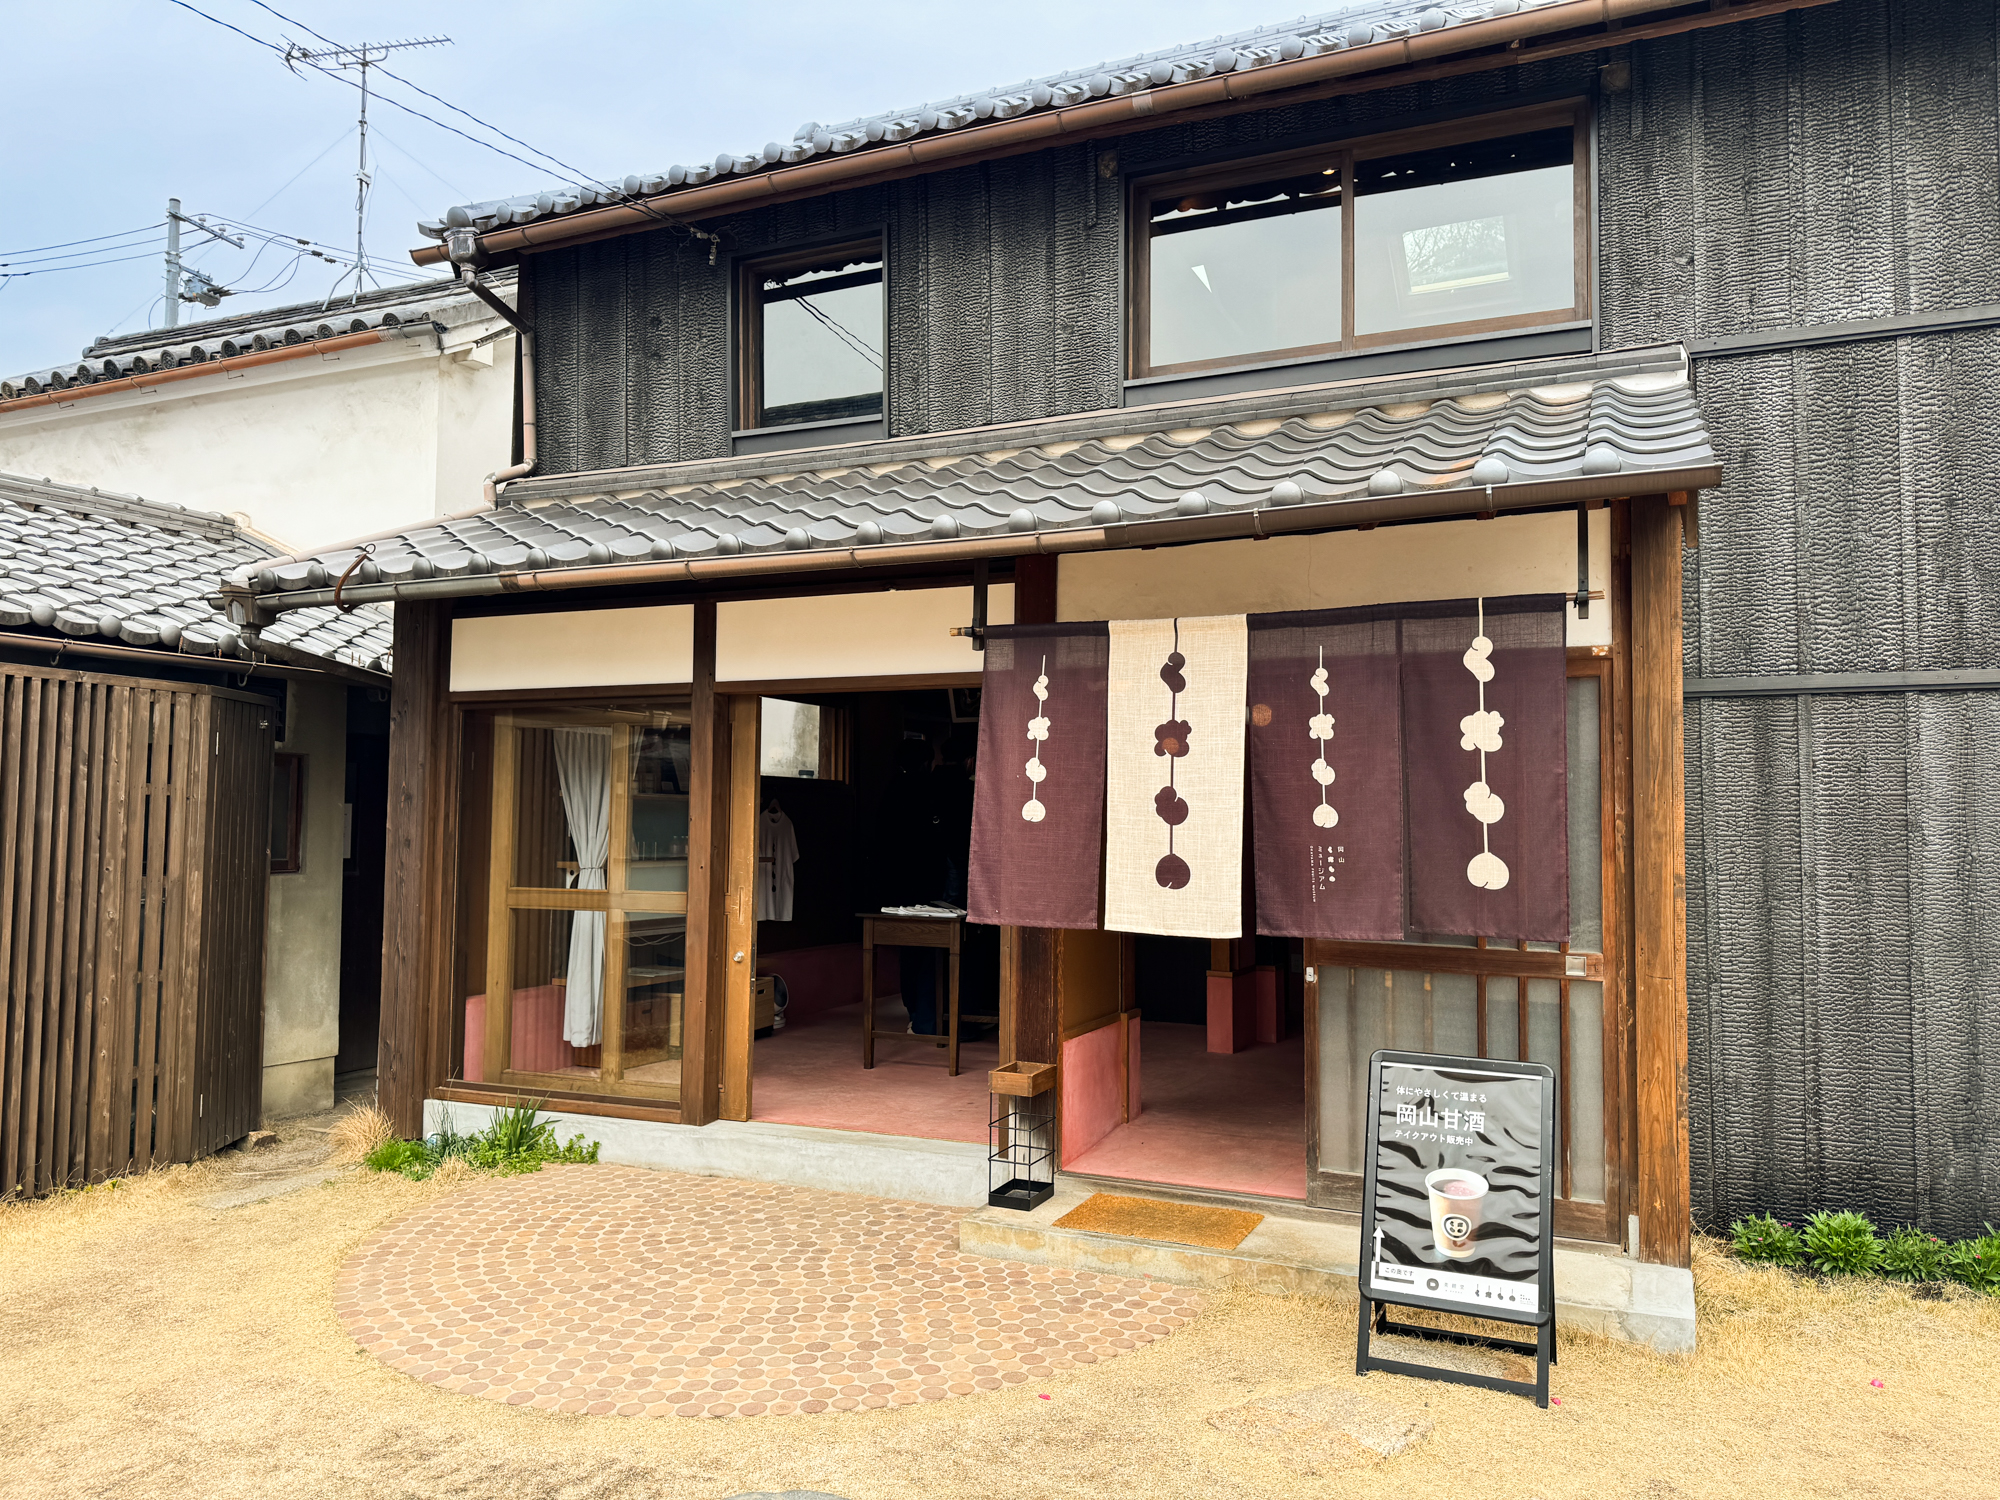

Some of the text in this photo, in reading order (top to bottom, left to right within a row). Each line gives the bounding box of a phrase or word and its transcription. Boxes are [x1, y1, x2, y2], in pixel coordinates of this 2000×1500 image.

[1337, 846, 1344, 863] 岡山
[1318, 845, 1326, 890] ミュージアム
[1396, 1085, 1487, 1103] 体にやさしくて温まる
[1396, 1103, 1486, 1133] 岡山甘酒
[1394, 1129, 1474, 1146] テイクアウト販売中
